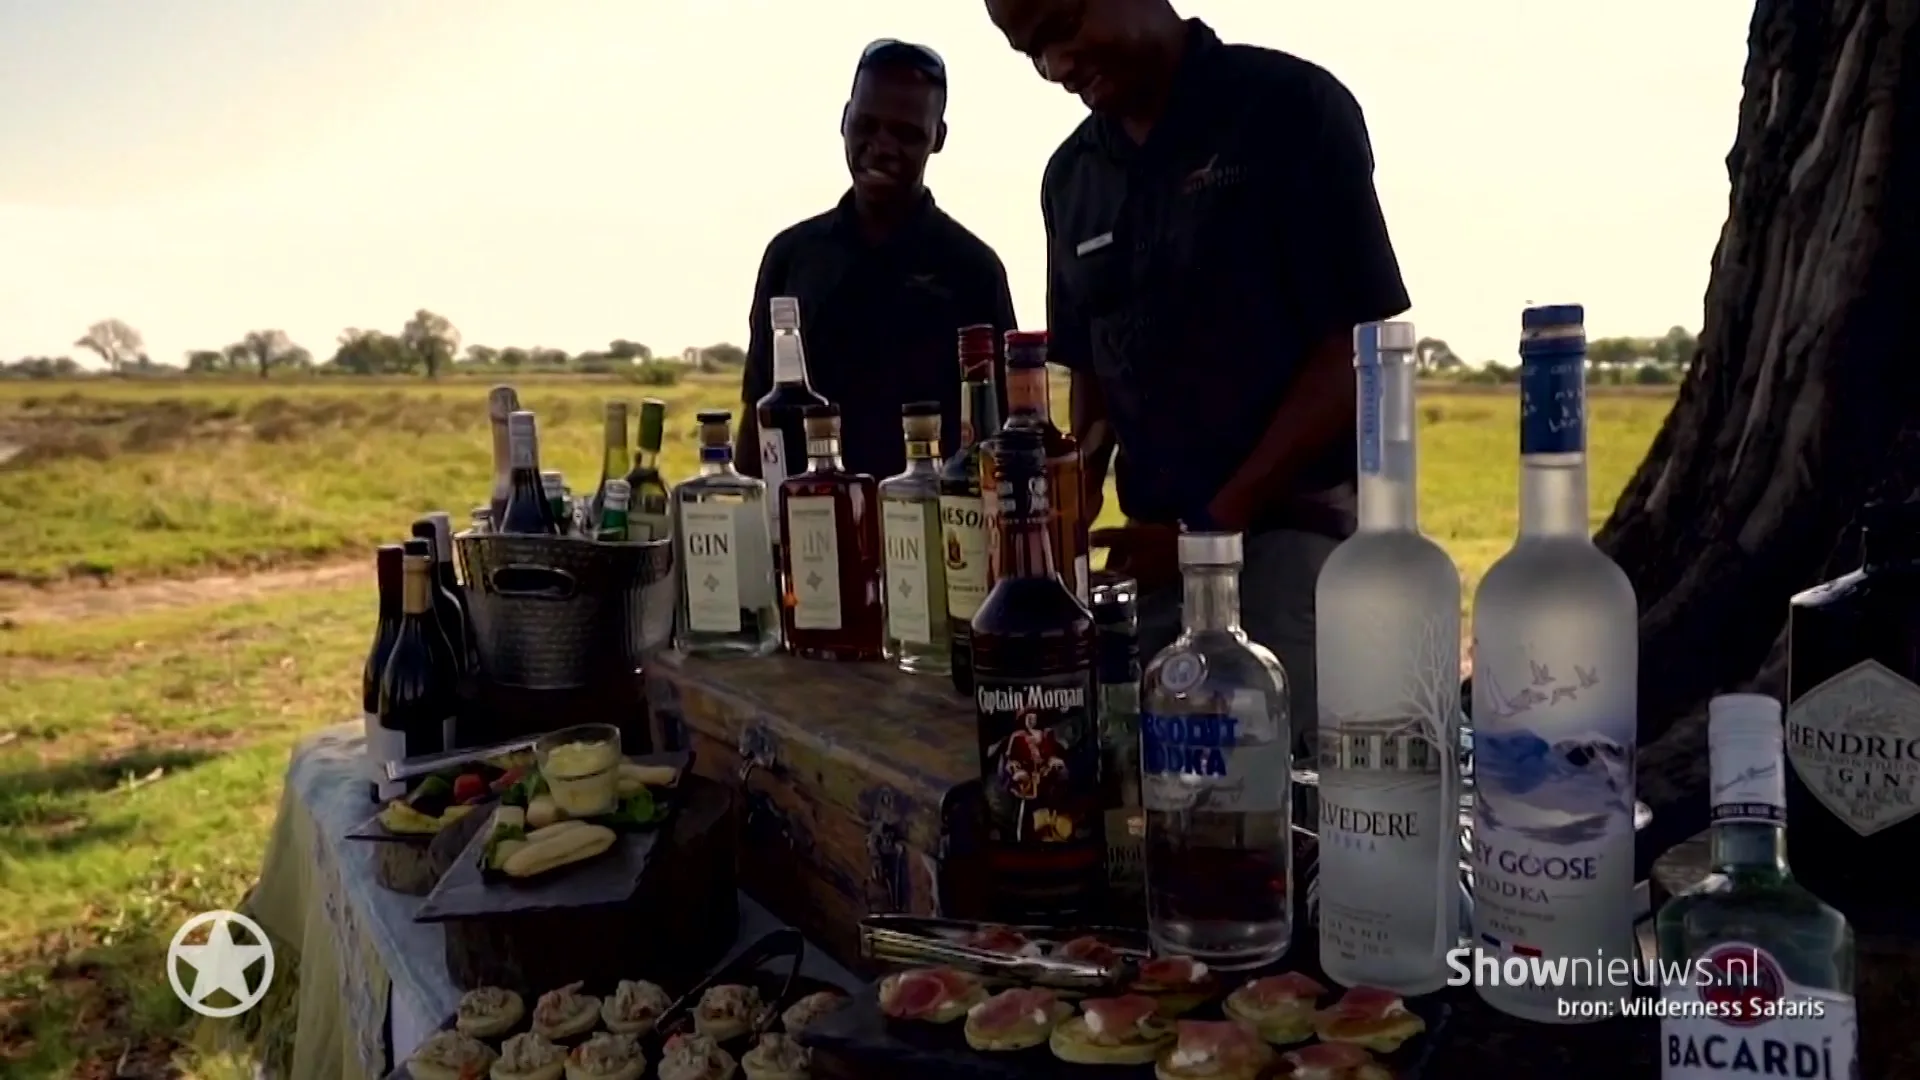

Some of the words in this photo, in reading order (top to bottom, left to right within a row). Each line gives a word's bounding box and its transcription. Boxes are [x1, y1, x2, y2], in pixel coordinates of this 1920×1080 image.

[689, 532, 728, 556] GIN
[977, 684, 1024, 715] Captain
[1027, 683, 1085, 713] Morgan
[1838, 767, 1900, 787] GIN
[1498, 848, 1597, 881] GOOSE
